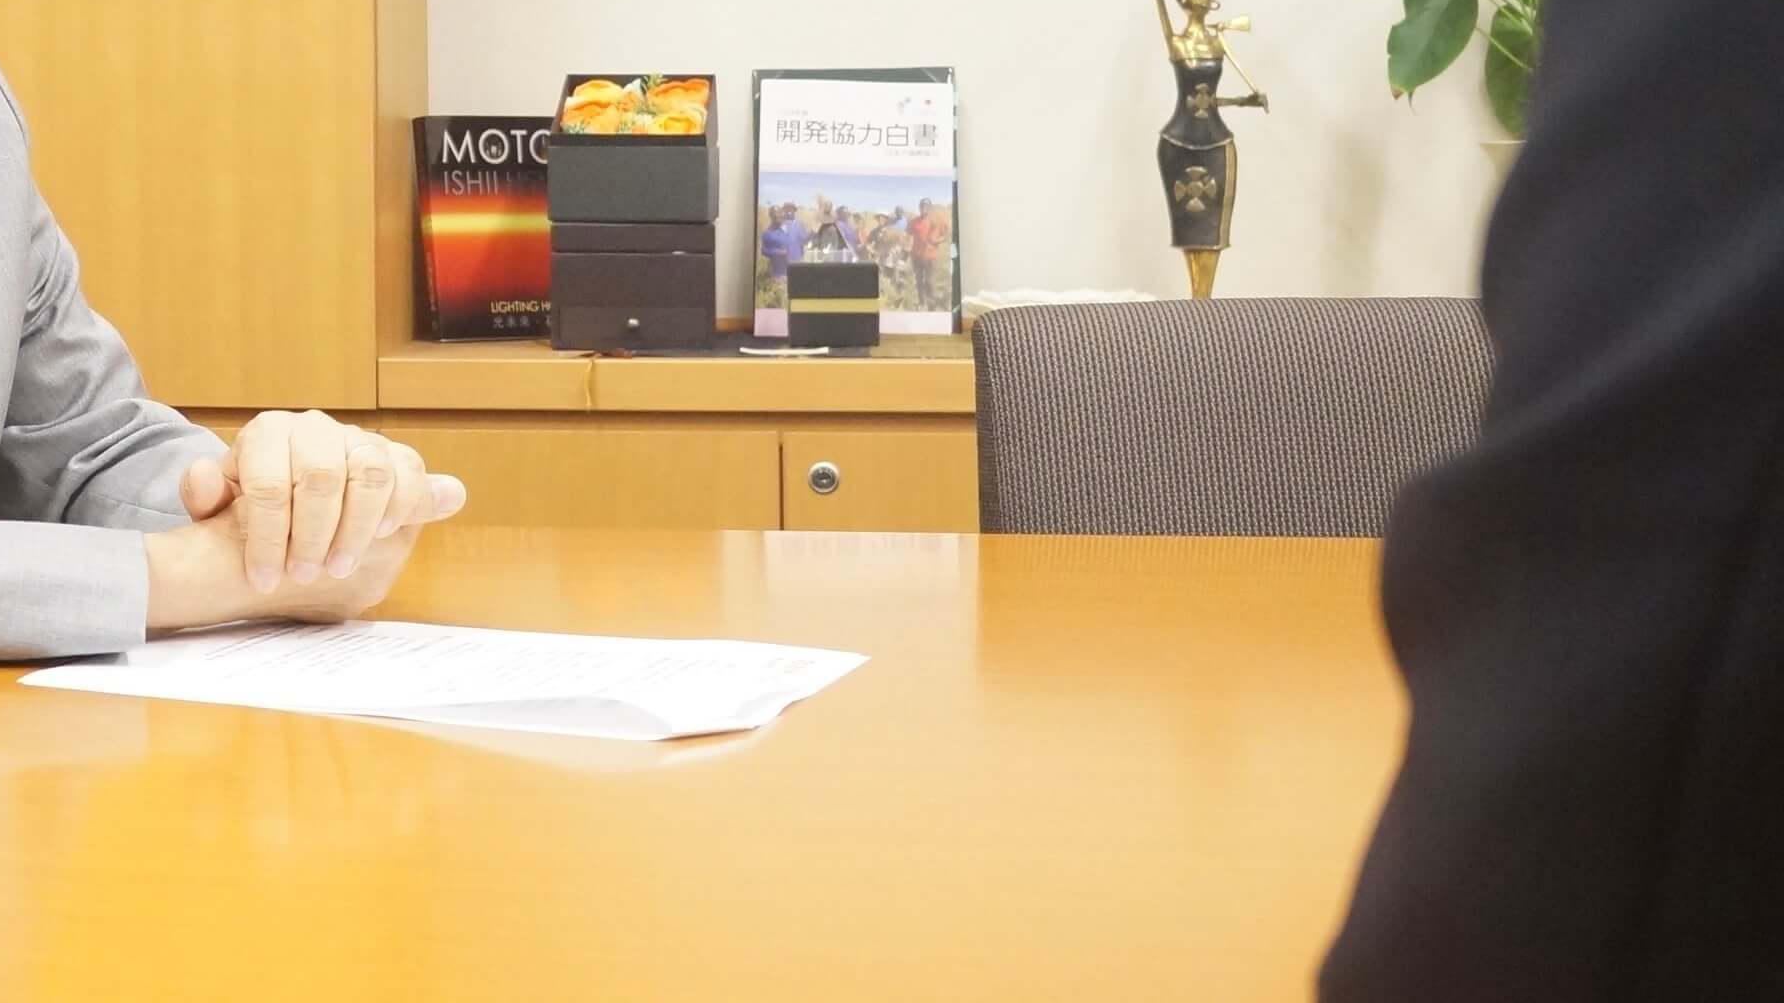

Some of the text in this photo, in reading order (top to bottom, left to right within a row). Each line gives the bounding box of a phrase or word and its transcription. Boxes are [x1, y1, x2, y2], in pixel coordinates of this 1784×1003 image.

[776, 119, 936, 147] 開発協力白書
[444, 170, 499, 196] ISHII
[490, 300, 538, 313] LIGHTING
